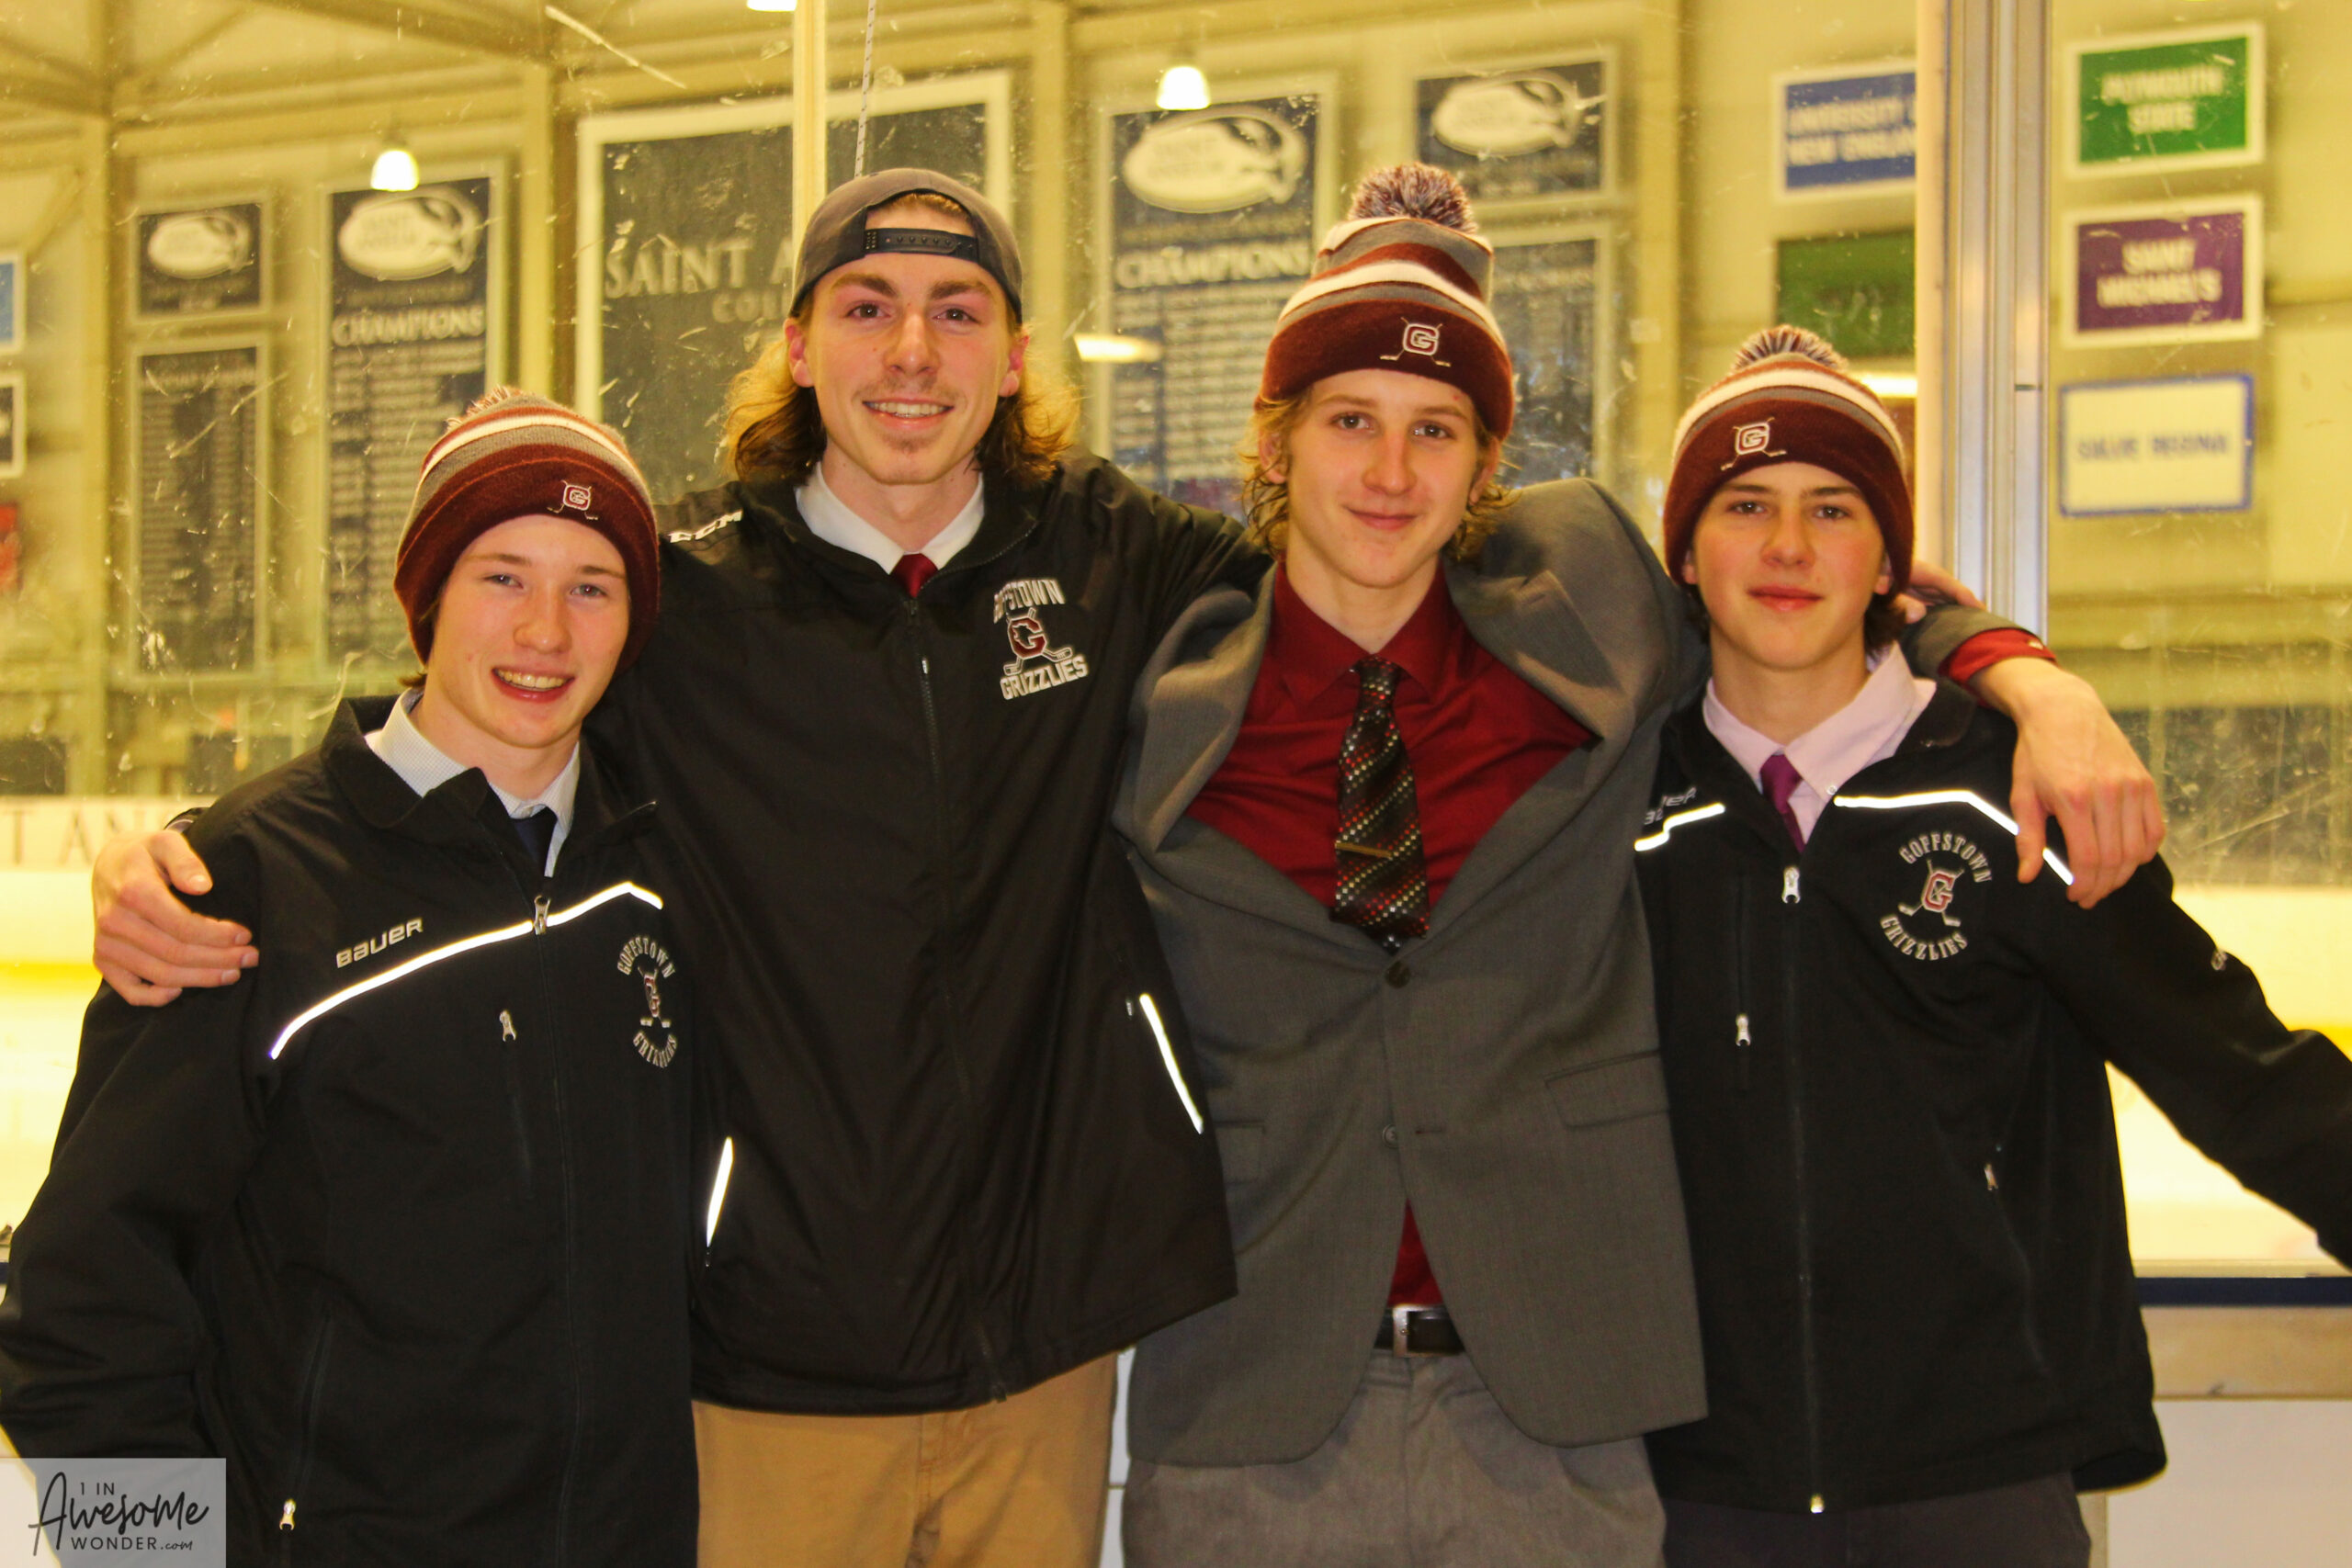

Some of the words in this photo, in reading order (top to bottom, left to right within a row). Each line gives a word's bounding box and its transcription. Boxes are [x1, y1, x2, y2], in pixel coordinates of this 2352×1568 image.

[605, 237, 753, 299] SAINT
[332, 304, 485, 347] CHAMPIONS
[1008, 615, 1047, 660] G
[1000, 653, 1090, 701] GRIZZLIES
[1898, 831, 1993, 884] GOFFSTOWN
[1921, 870, 1955, 913] G
[616, 935, 676, 979] GOFFSTOWN
[1880, 915, 1969, 961] GRIZZLIES
